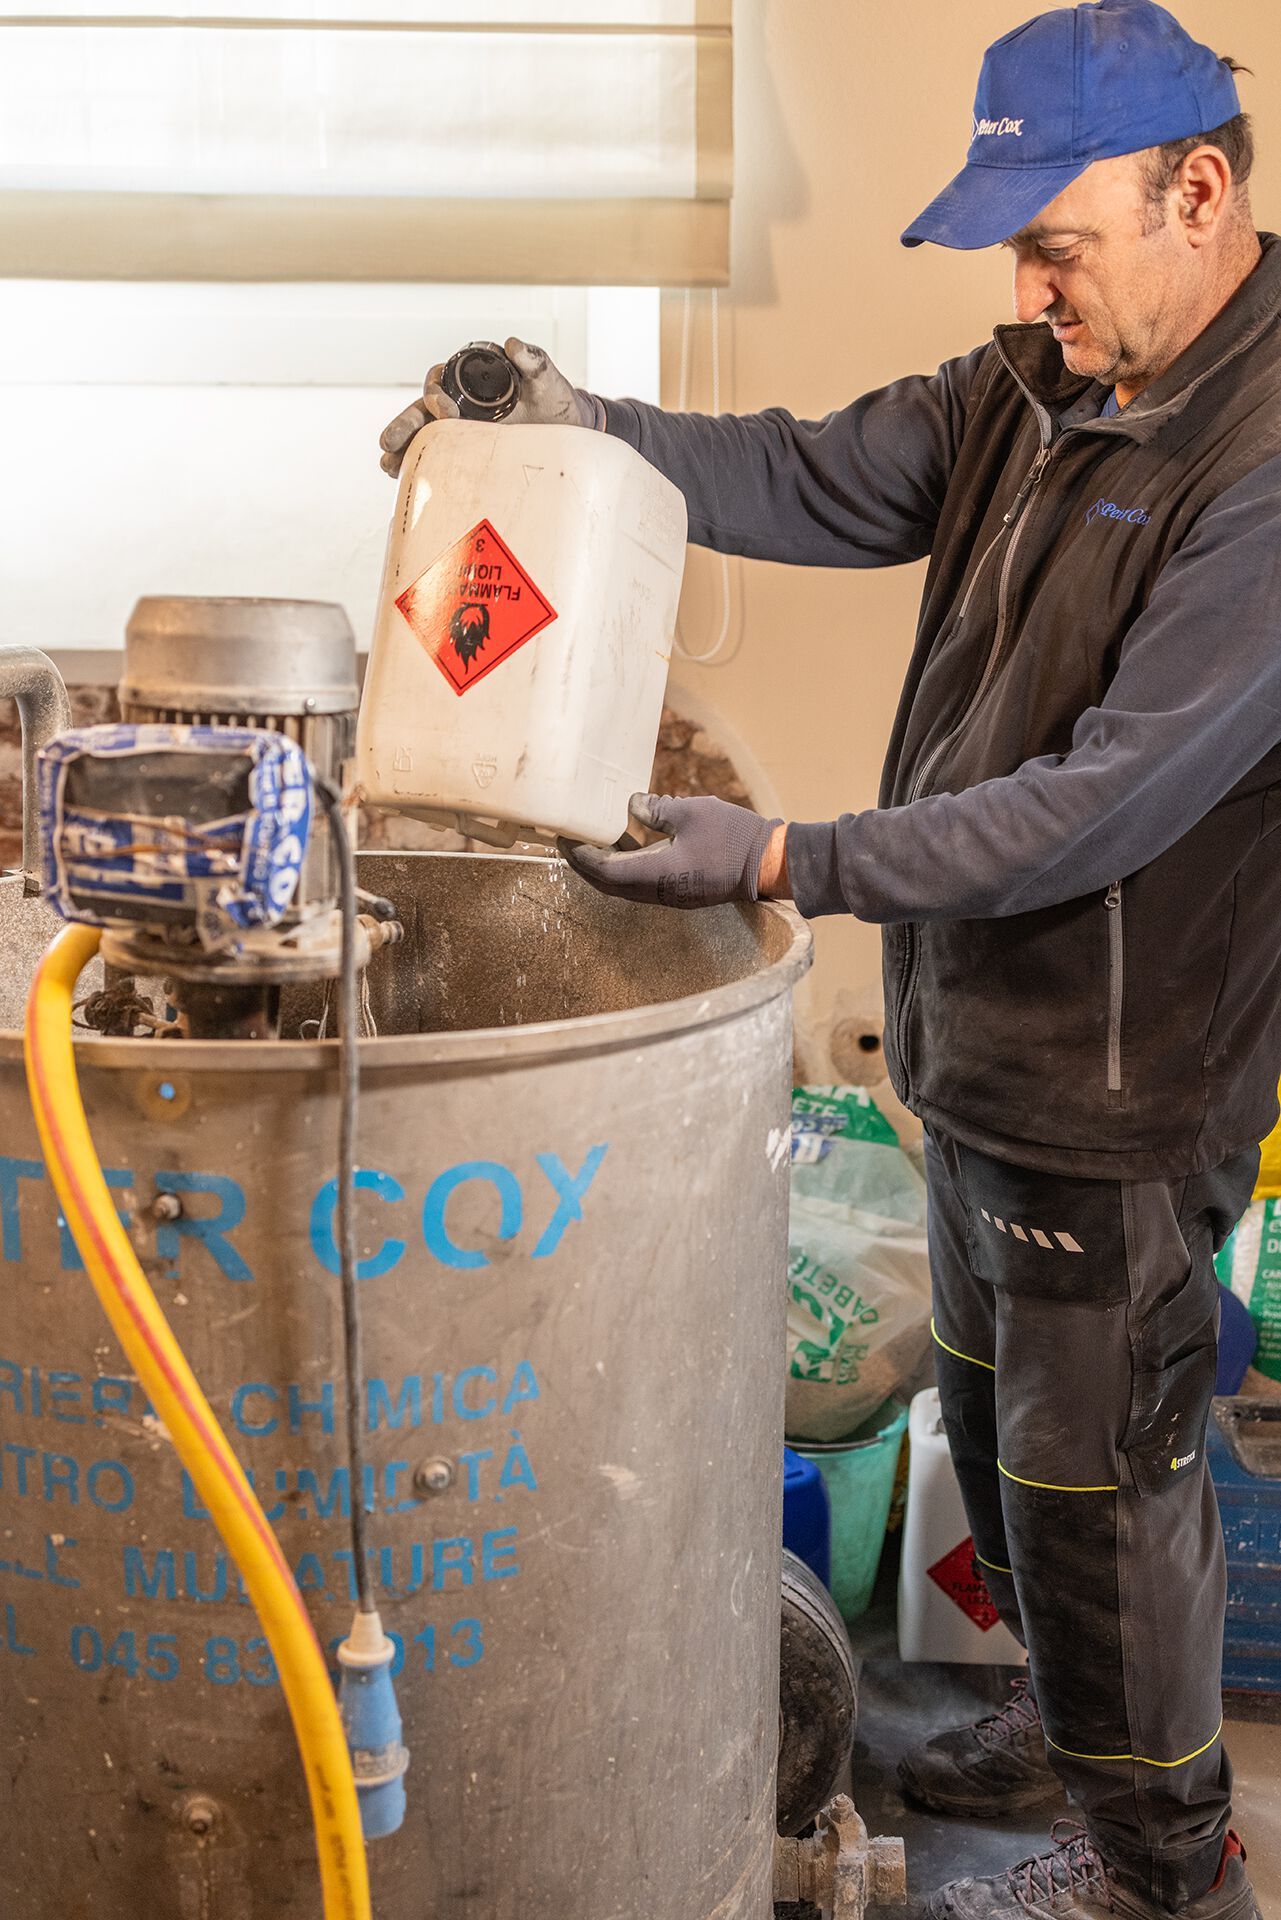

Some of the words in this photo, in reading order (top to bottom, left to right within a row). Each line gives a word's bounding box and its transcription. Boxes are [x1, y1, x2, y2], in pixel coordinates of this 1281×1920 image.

[997, 117, 1024, 136] Cox
[475, 538, 486, 553] 3
[309, 1142, 609, 1281] COX
[231, 1360, 541, 1437] CHMICA
[123, 1526, 519, 1604] MUATURE
[69, 1625, 181, 1682] 045
